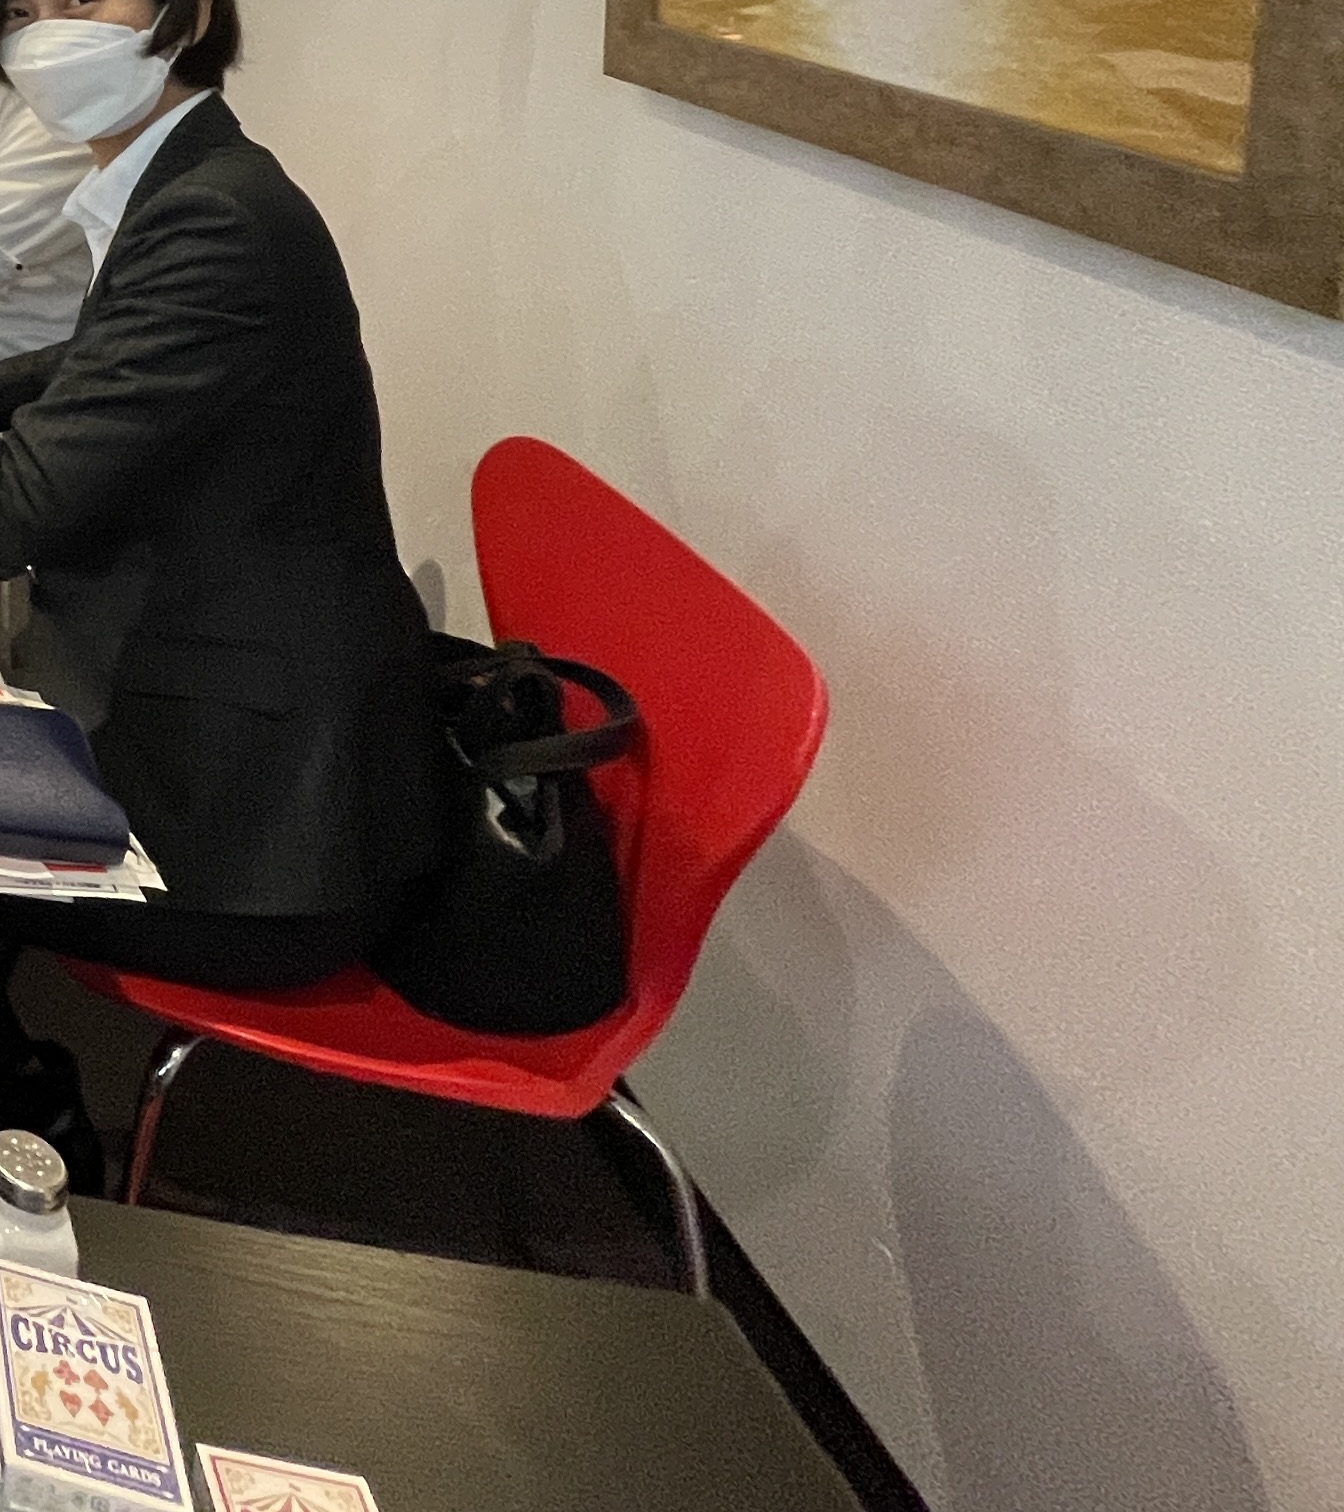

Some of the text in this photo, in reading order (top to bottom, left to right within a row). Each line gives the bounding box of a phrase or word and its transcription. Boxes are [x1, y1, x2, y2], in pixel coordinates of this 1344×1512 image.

[10, 1313, 144, 1385] CIRCUS
[32, 1436, 162, 1488] PLAYING CARDS
